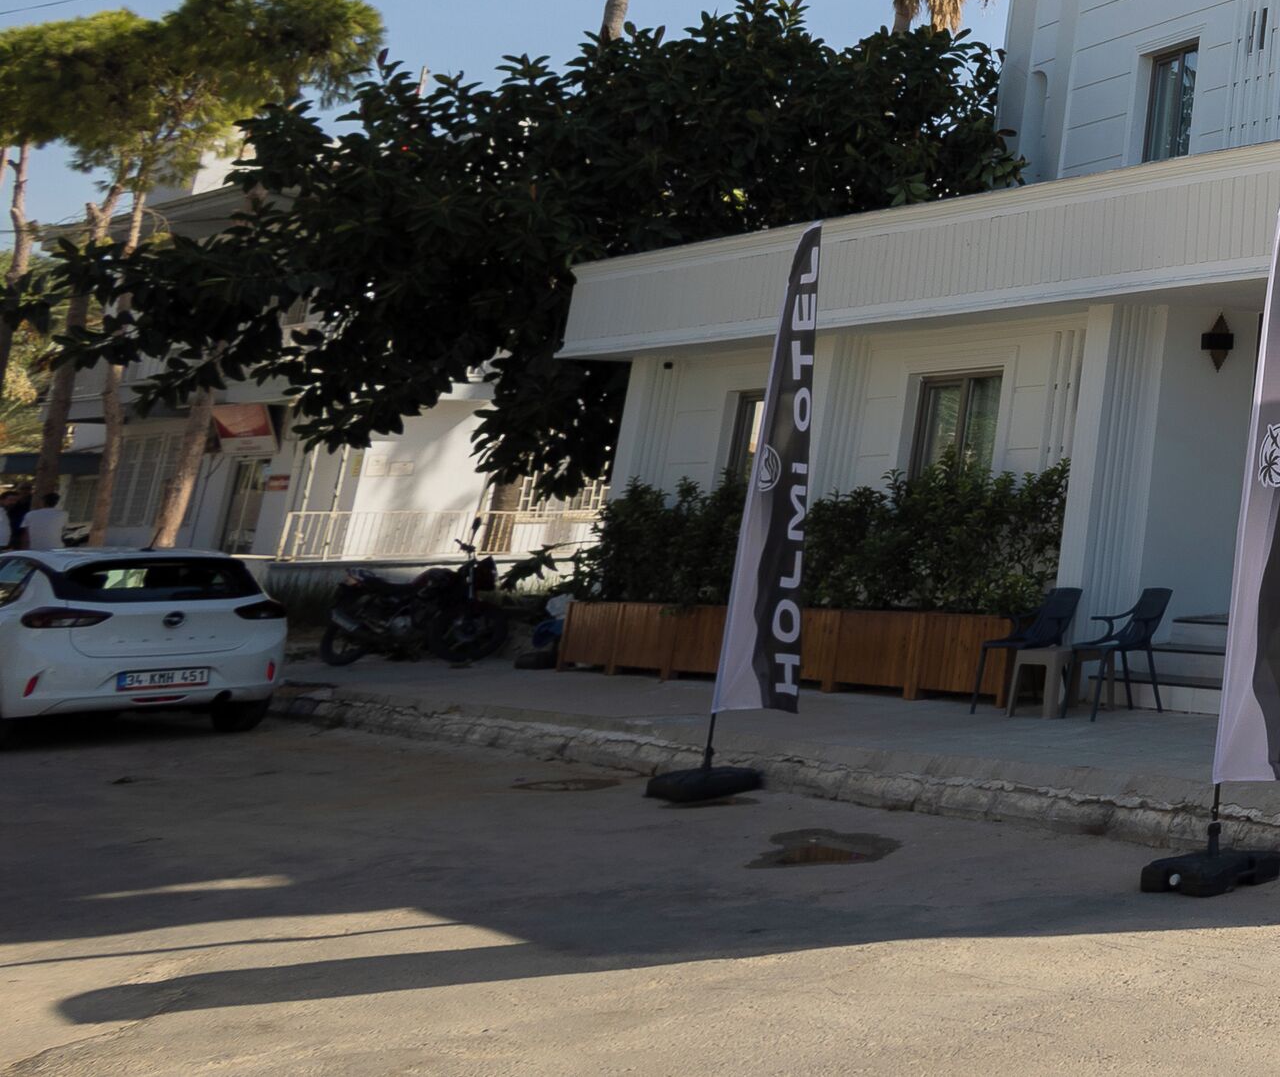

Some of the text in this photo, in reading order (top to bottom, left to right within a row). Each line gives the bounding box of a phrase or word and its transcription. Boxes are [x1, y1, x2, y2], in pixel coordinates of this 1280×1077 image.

[791, 246, 819, 433] OTEL
[127, 670, 205, 686] 34 KMH 451
